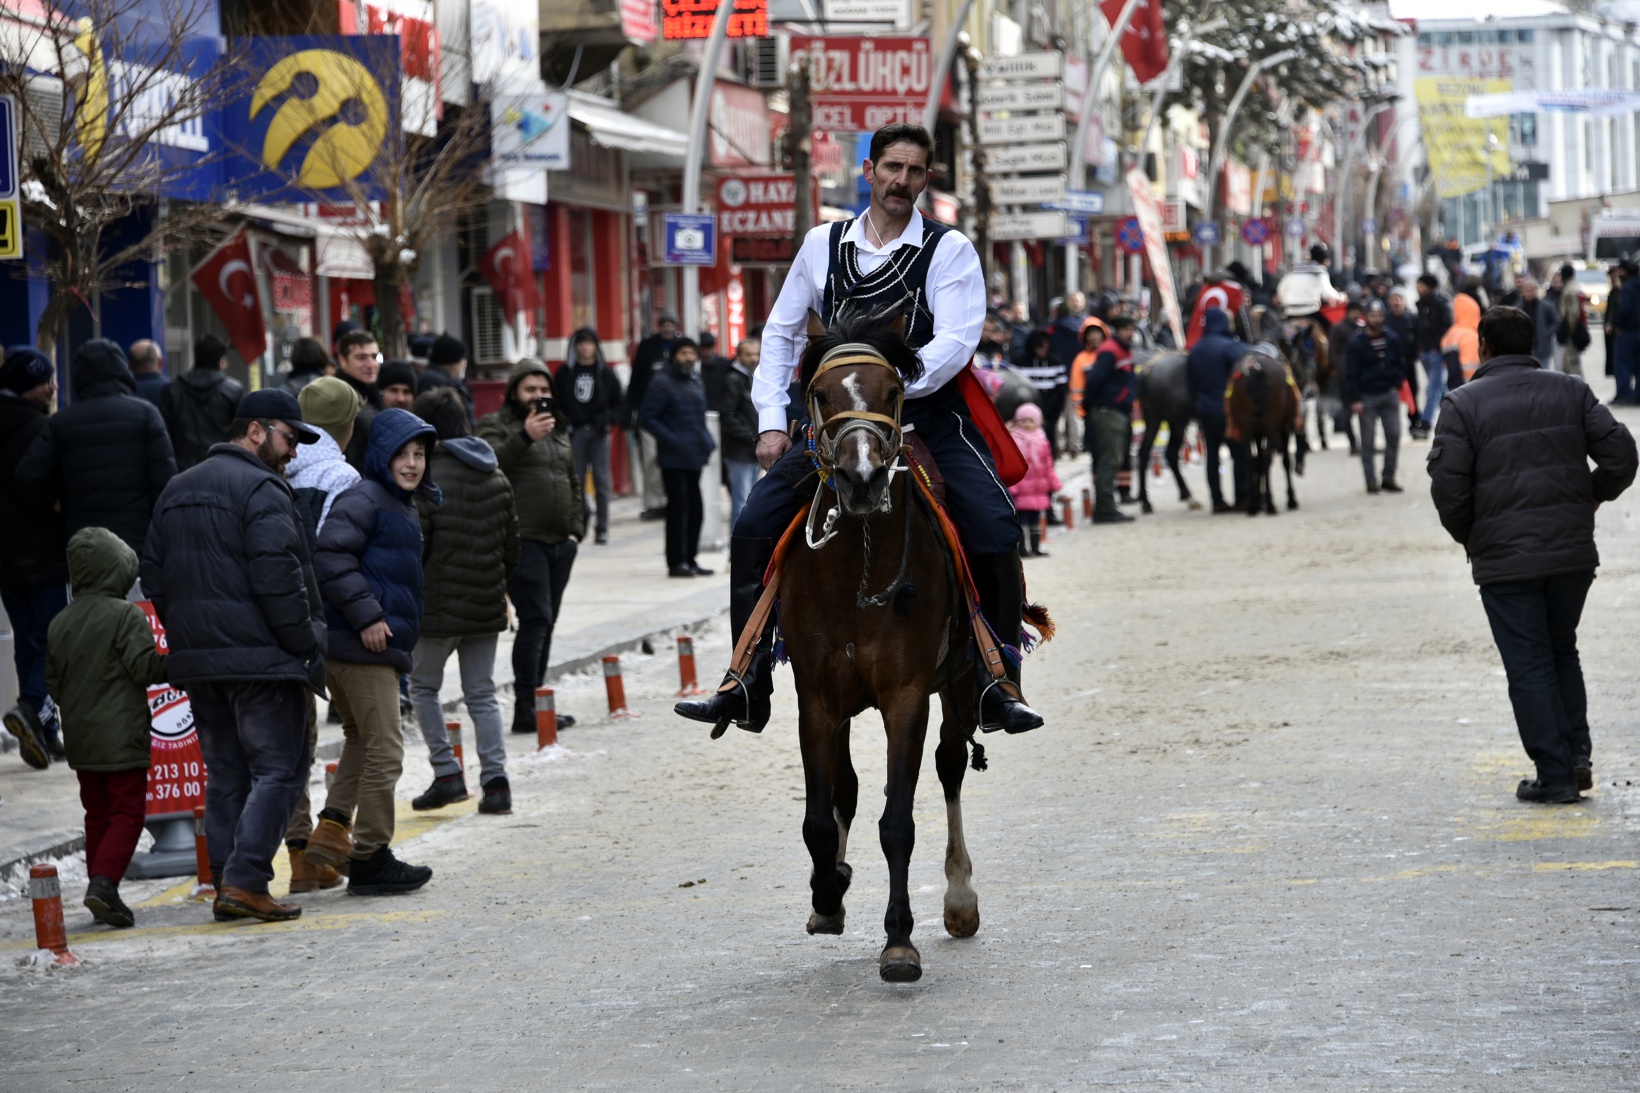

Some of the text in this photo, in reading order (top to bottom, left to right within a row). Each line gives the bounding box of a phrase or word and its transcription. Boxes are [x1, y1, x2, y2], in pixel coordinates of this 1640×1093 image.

[153, 763, 179, 780] 213
[183, 761, 199, 777] 10
[155, 783, 181, 800] 376
[183, 781, 201, 797] 00
